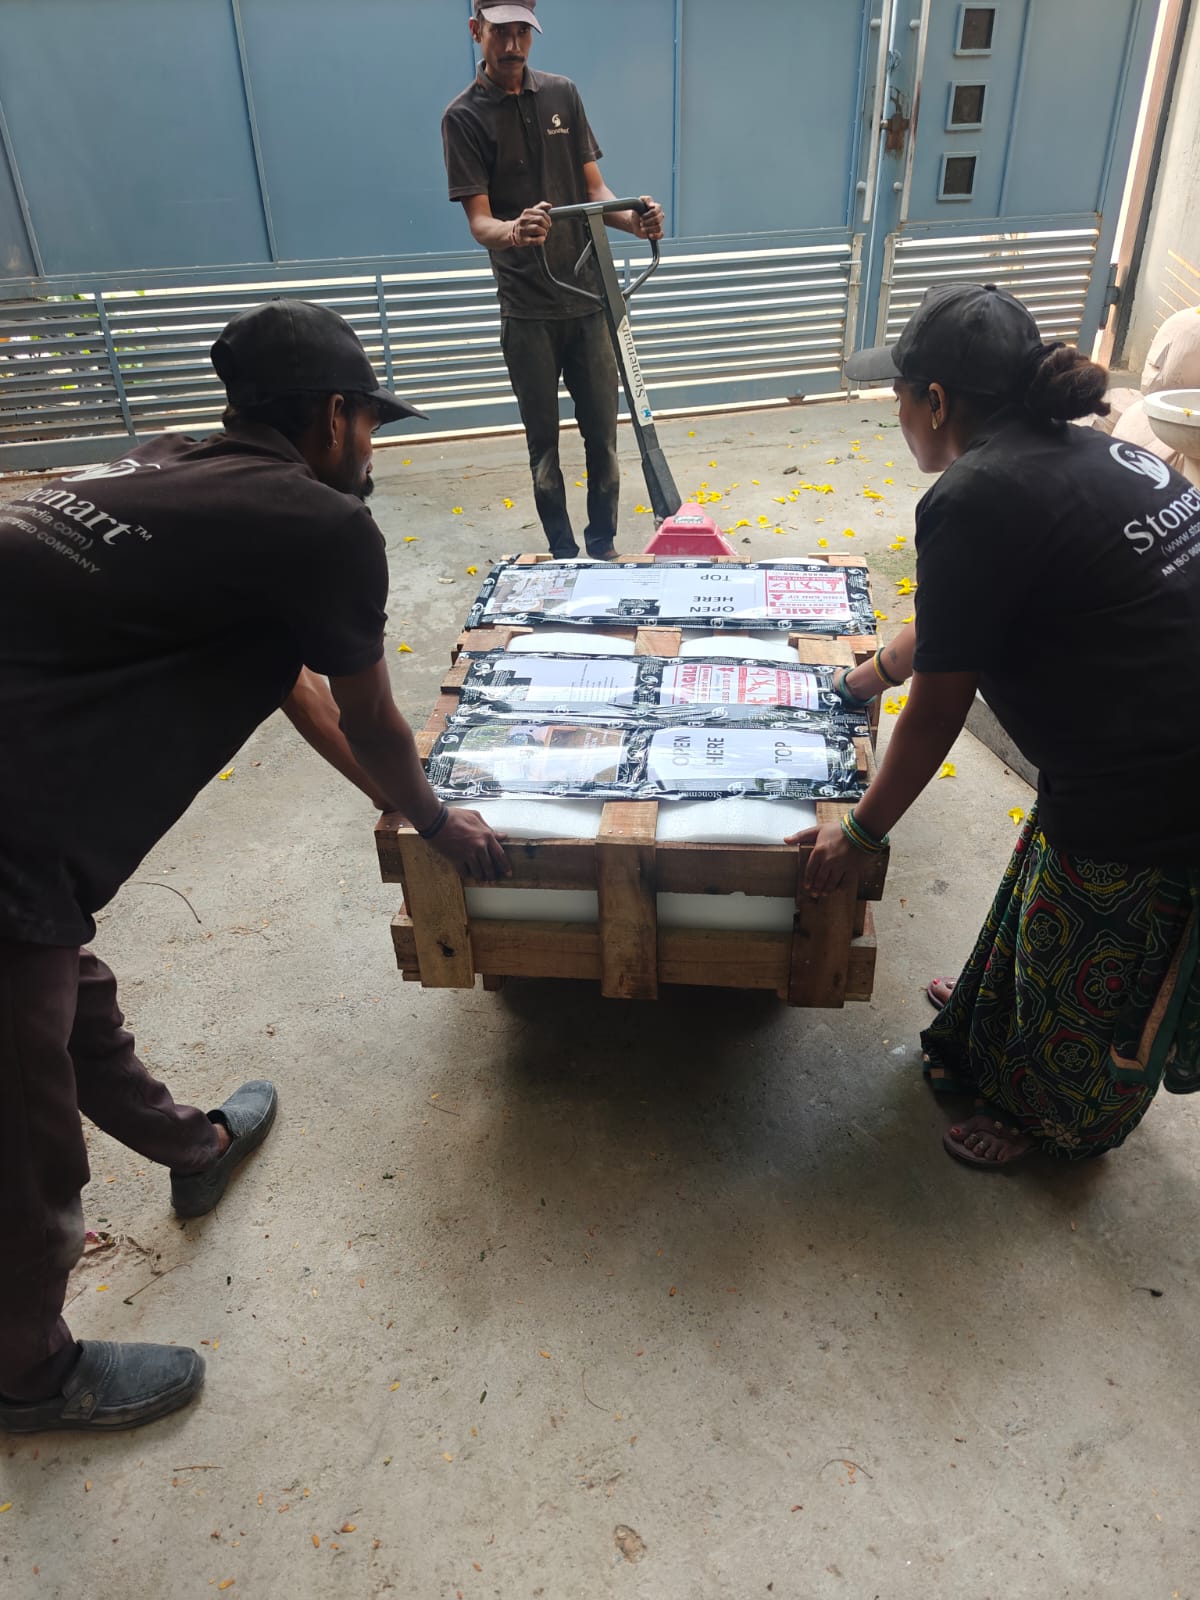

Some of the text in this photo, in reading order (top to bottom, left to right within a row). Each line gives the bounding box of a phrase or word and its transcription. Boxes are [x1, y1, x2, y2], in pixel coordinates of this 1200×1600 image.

[37, 531, 101, 575] COMPANY
[1161, 563, 1176, 577] AN
[1173, 553, 1190, 568] ISO
[700, 574, 730, 582] TOP
[679, 664, 698, 704] AGILE
[672, 735, 691, 767] OPEN
[706, 737, 725, 766] HERE
[775, 741, 793, 764] TOP
